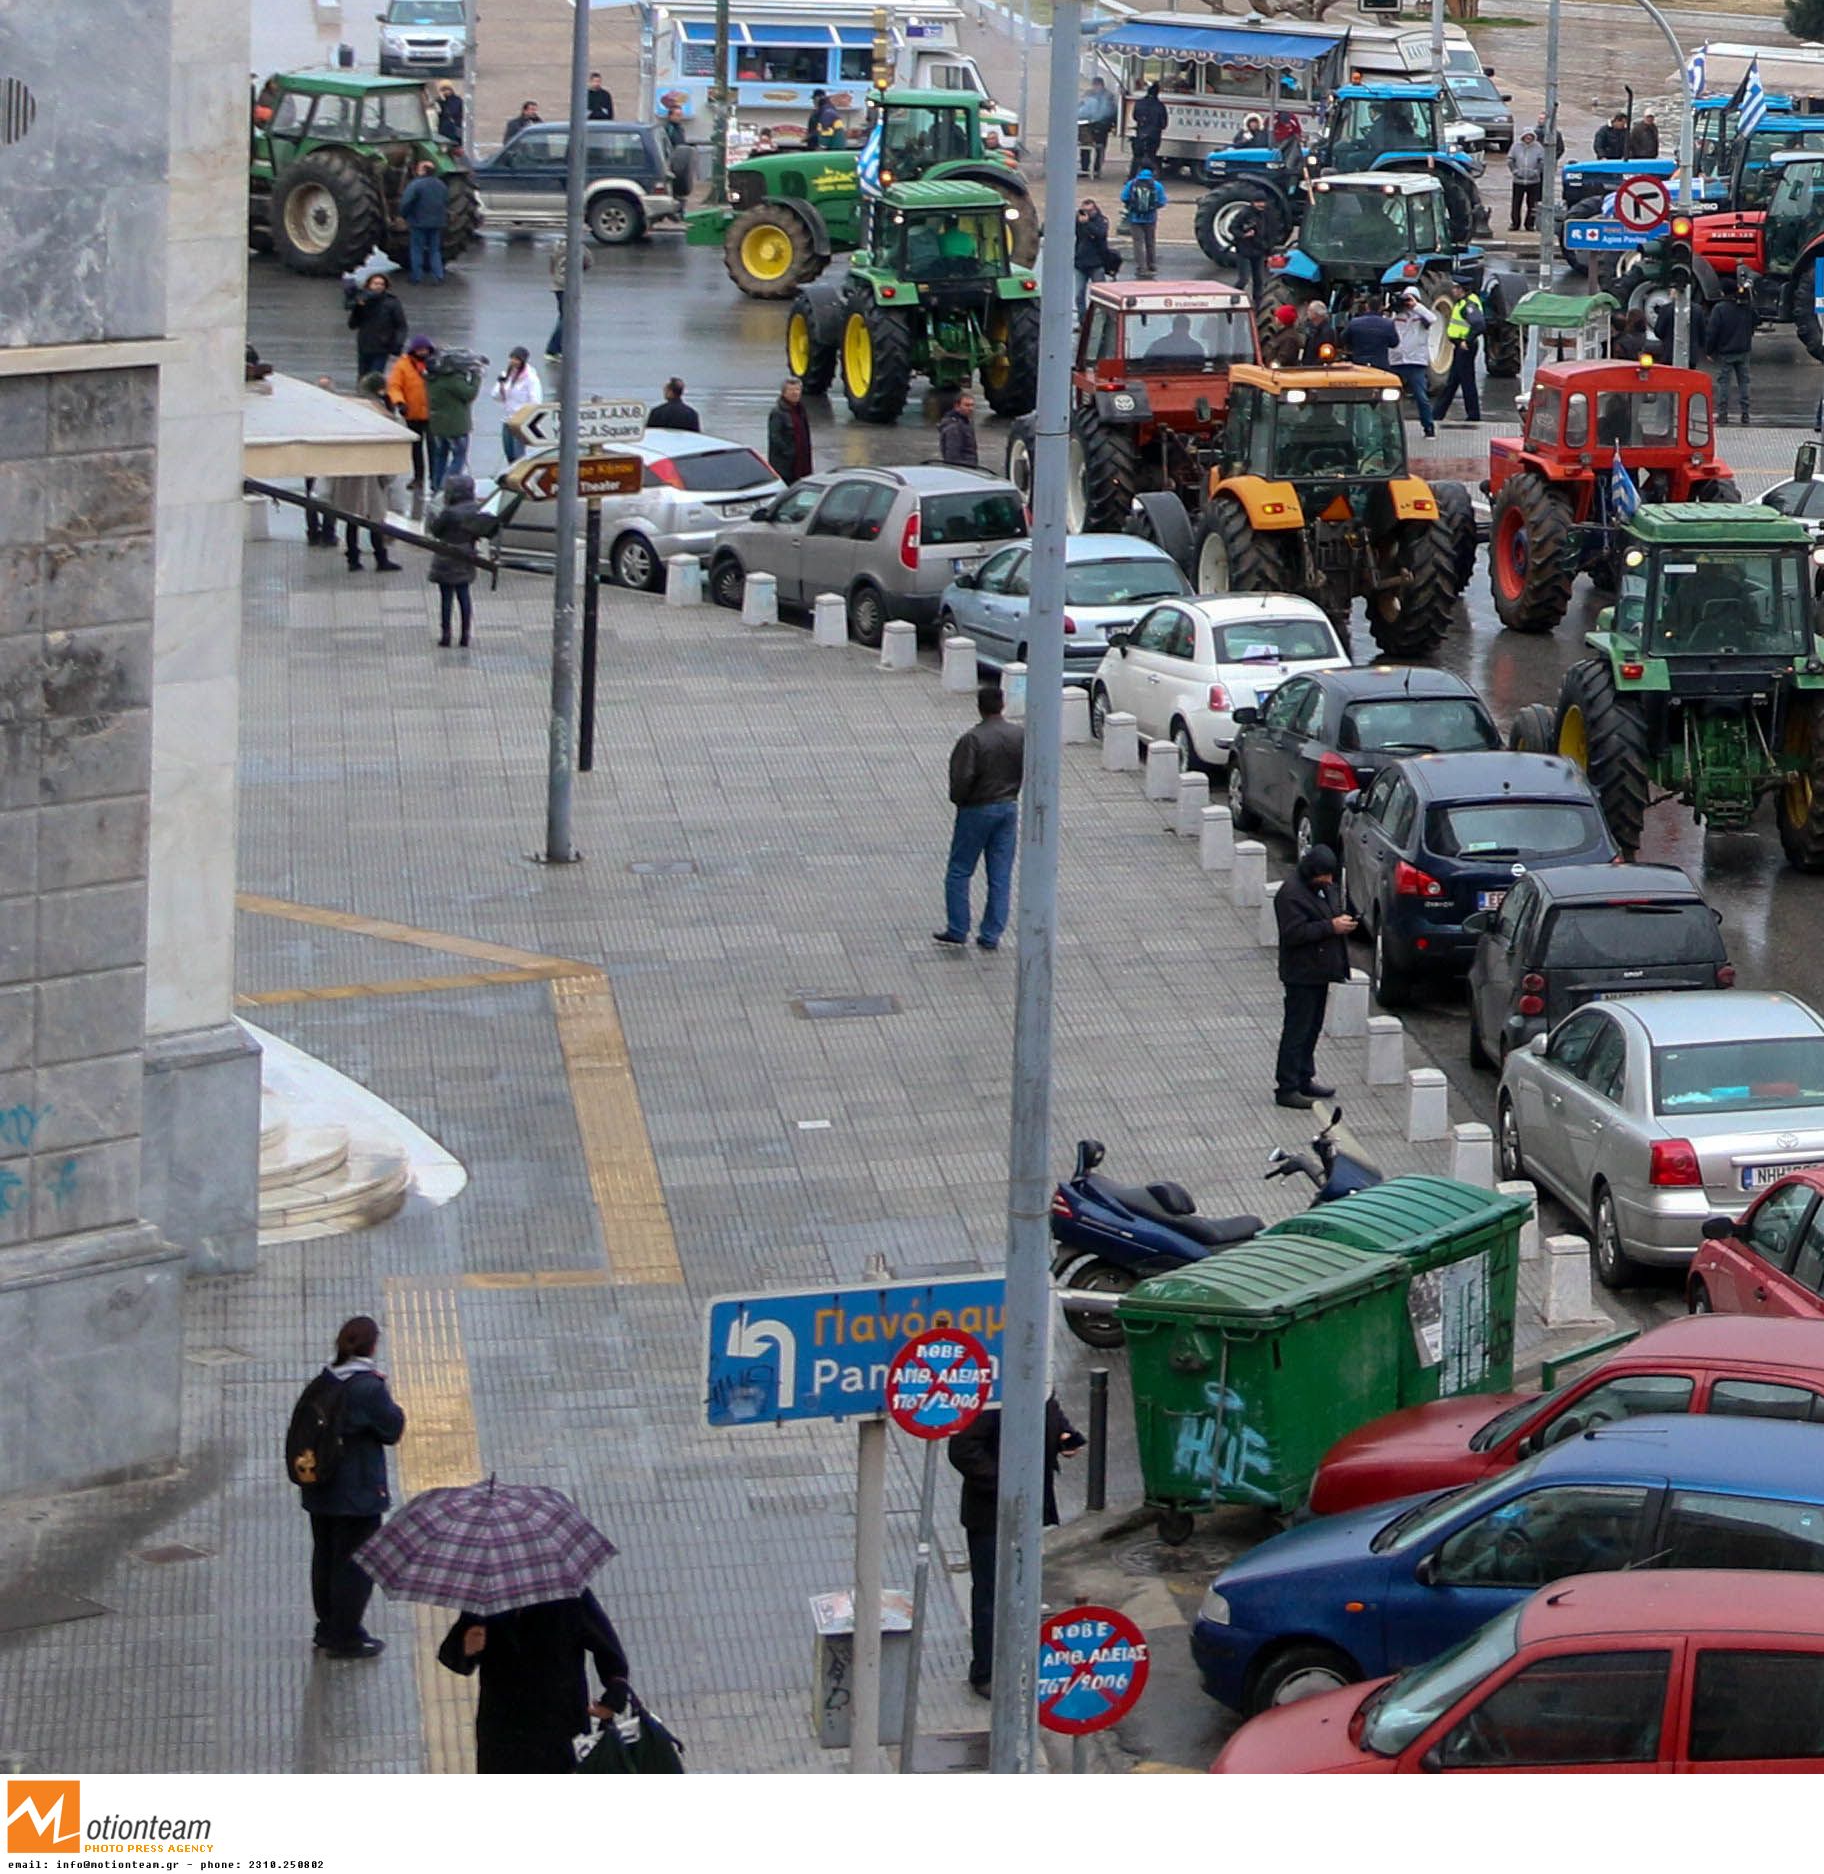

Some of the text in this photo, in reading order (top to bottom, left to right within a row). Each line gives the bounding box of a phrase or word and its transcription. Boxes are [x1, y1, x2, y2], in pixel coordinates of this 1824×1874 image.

[1051, 1621, 1109, 1640] ΚΘΒΕ
[1089, 1644, 1147, 1664] ΑΔΕΙΑΣ
[1039, 1672, 1128, 1695] 767/2006
